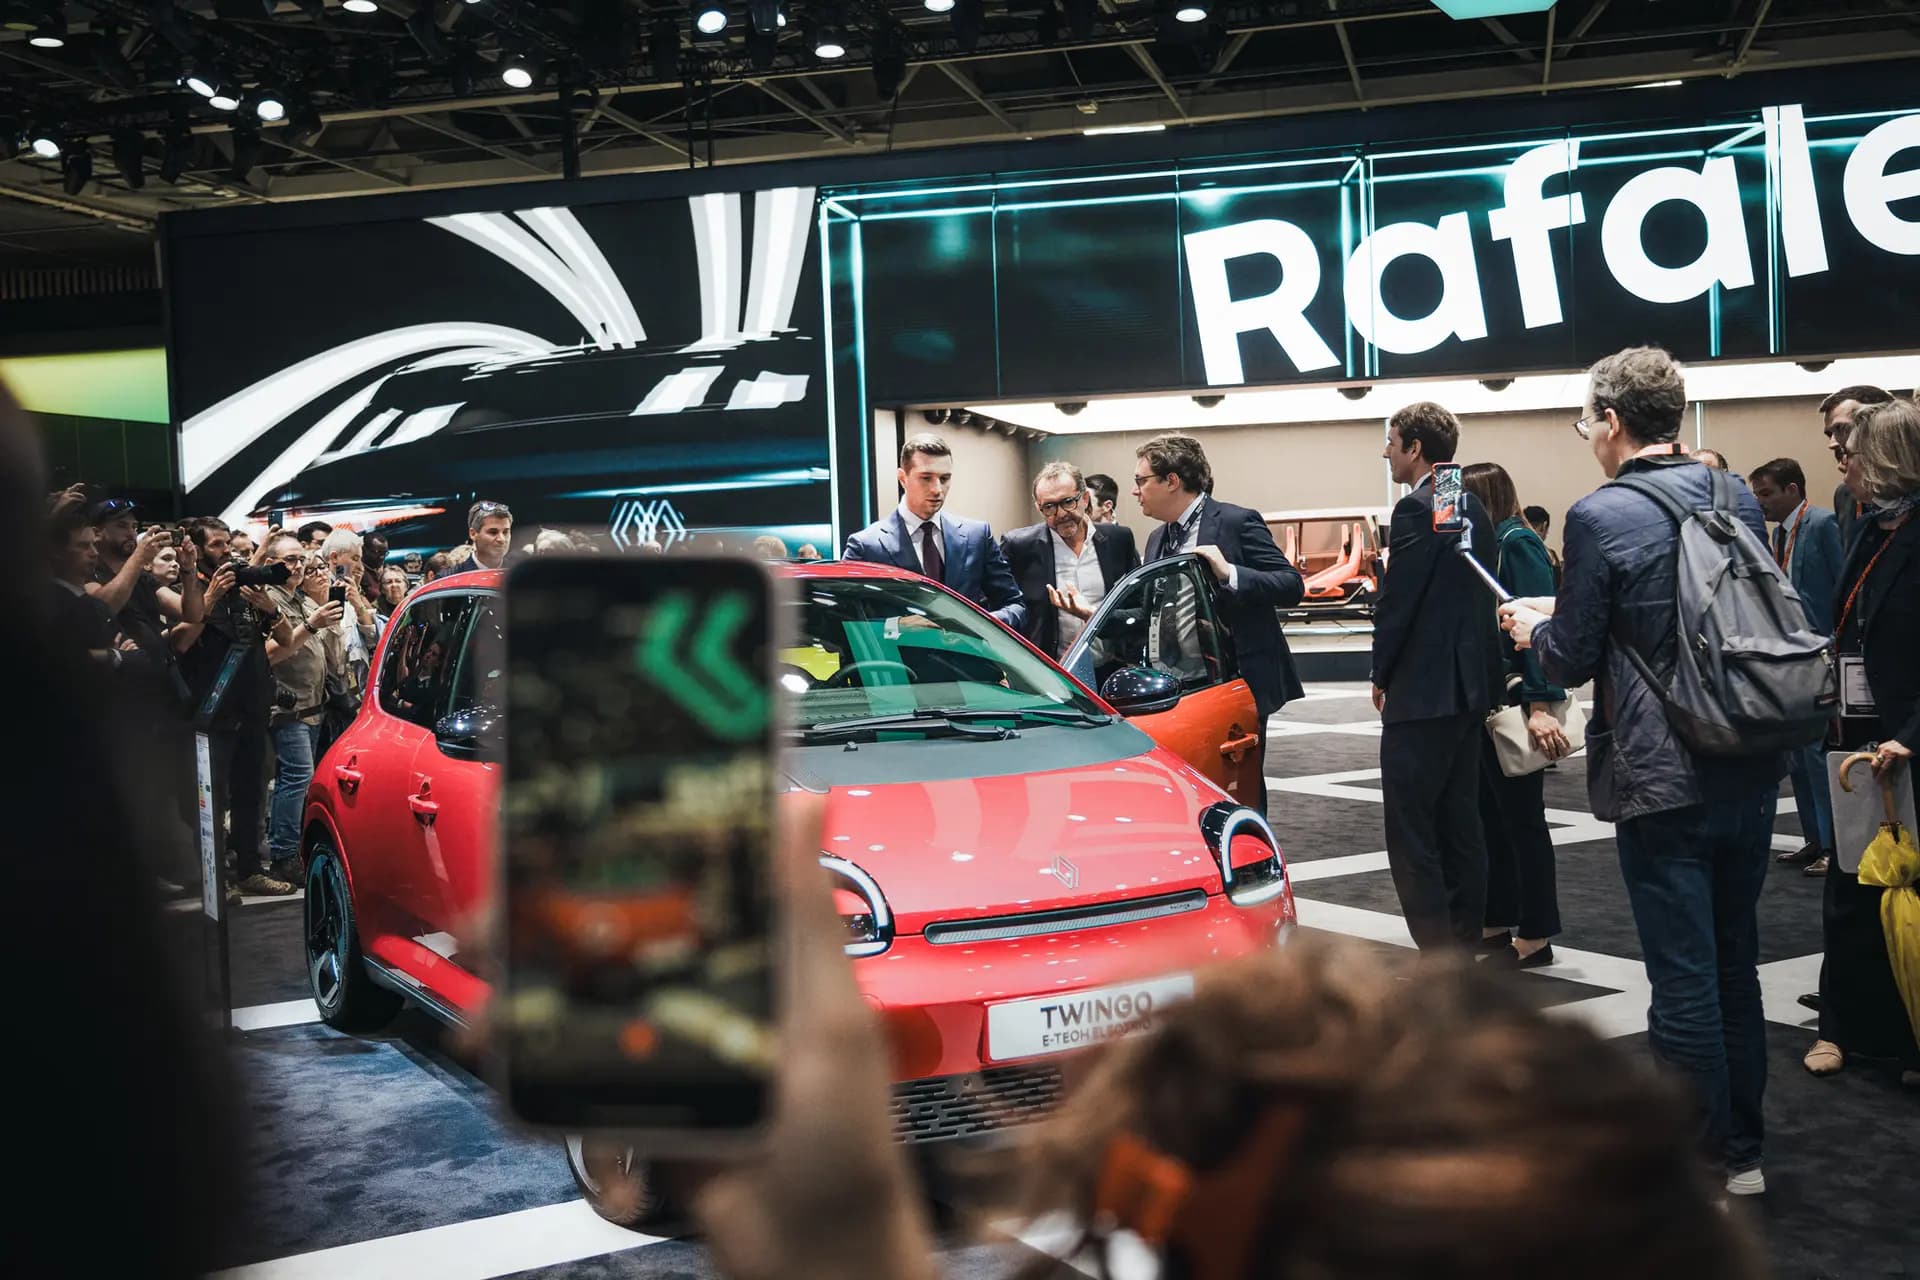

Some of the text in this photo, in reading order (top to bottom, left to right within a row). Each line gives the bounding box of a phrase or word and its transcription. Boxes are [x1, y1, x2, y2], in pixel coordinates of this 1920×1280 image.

[1183, 103, 1920, 386] Rafale
[1040, 991, 1152, 1029] TWINGO
[1042, 1028, 1090, 1047] E-TECH
